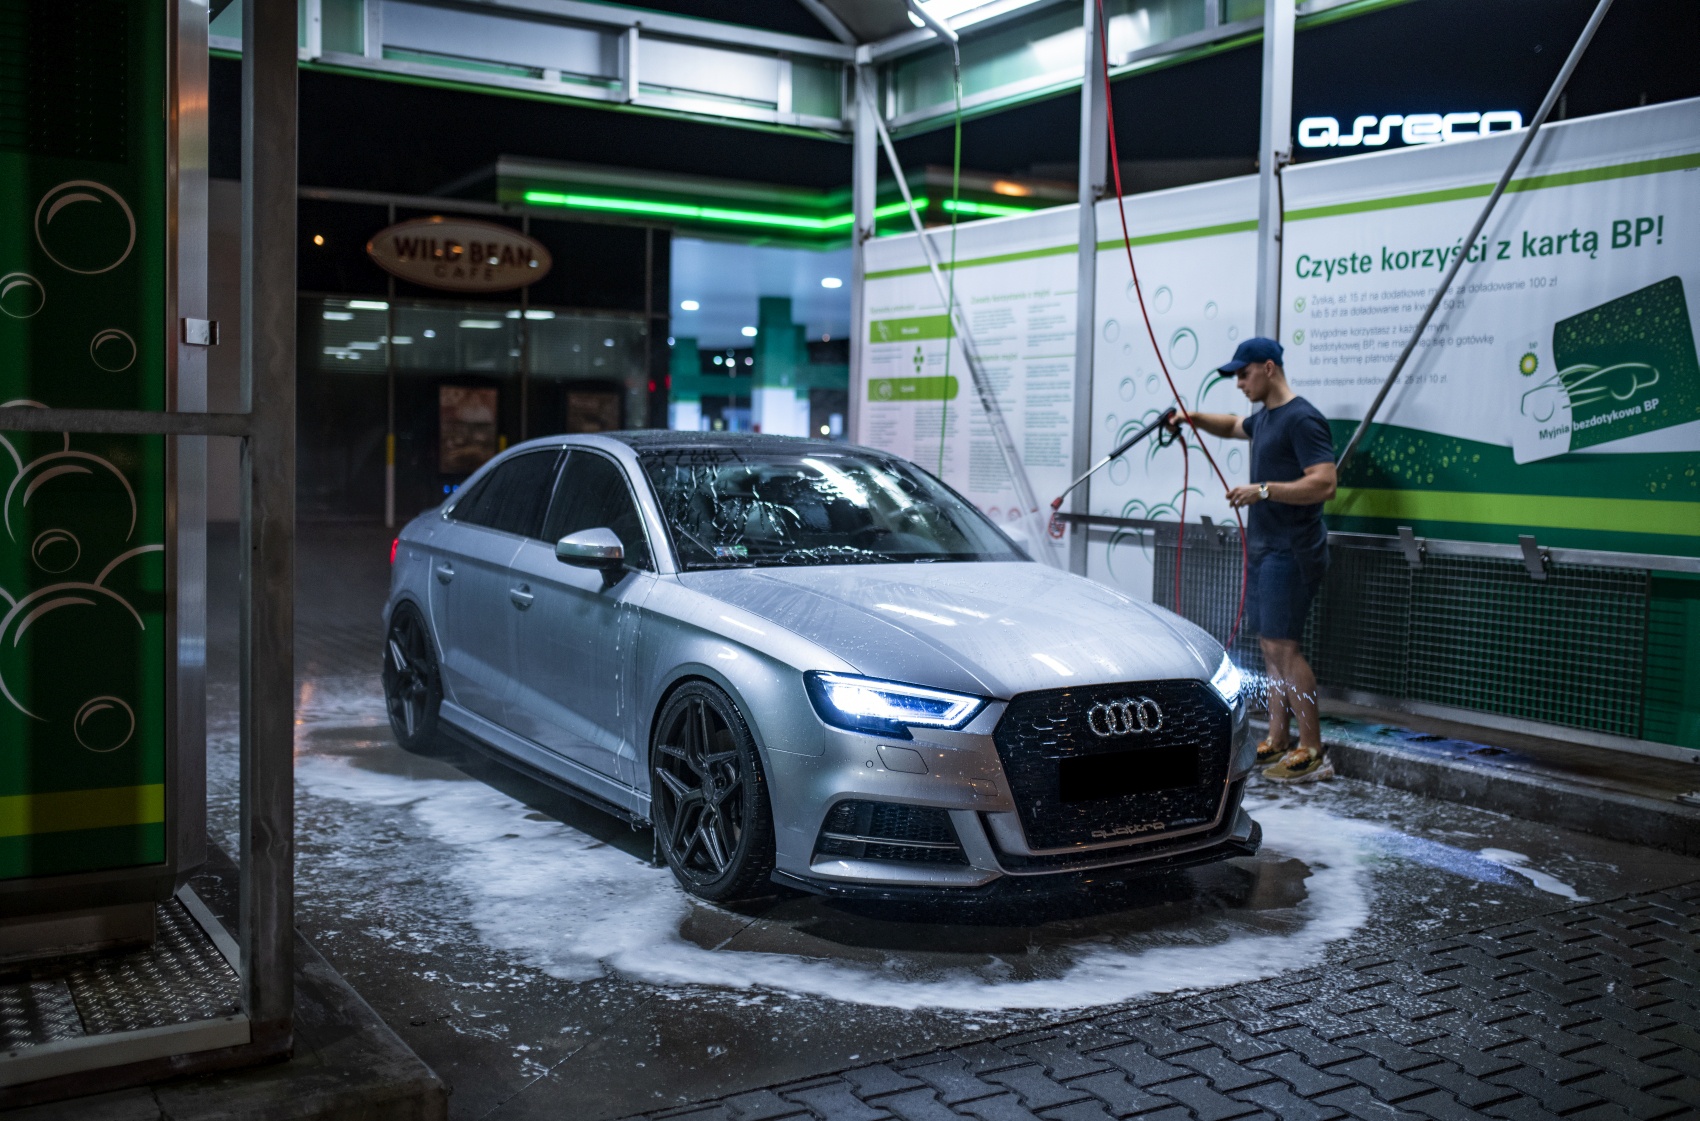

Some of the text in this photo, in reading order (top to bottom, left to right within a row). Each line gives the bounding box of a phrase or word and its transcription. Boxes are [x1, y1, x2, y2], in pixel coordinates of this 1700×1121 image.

[1299, 110, 1522, 147] asseco
[393, 236, 533, 267] WILD BEAN
[1296, 215, 1664, 282] Czyste korzyści z kartą BP!
[1468, 279, 1525, 294] doładowanie
[1529, 276, 1547, 288] 100
[1549, 275, 1558, 288] zł
[1539, 398, 1660, 440] Myjnia bezdotykowa BP
